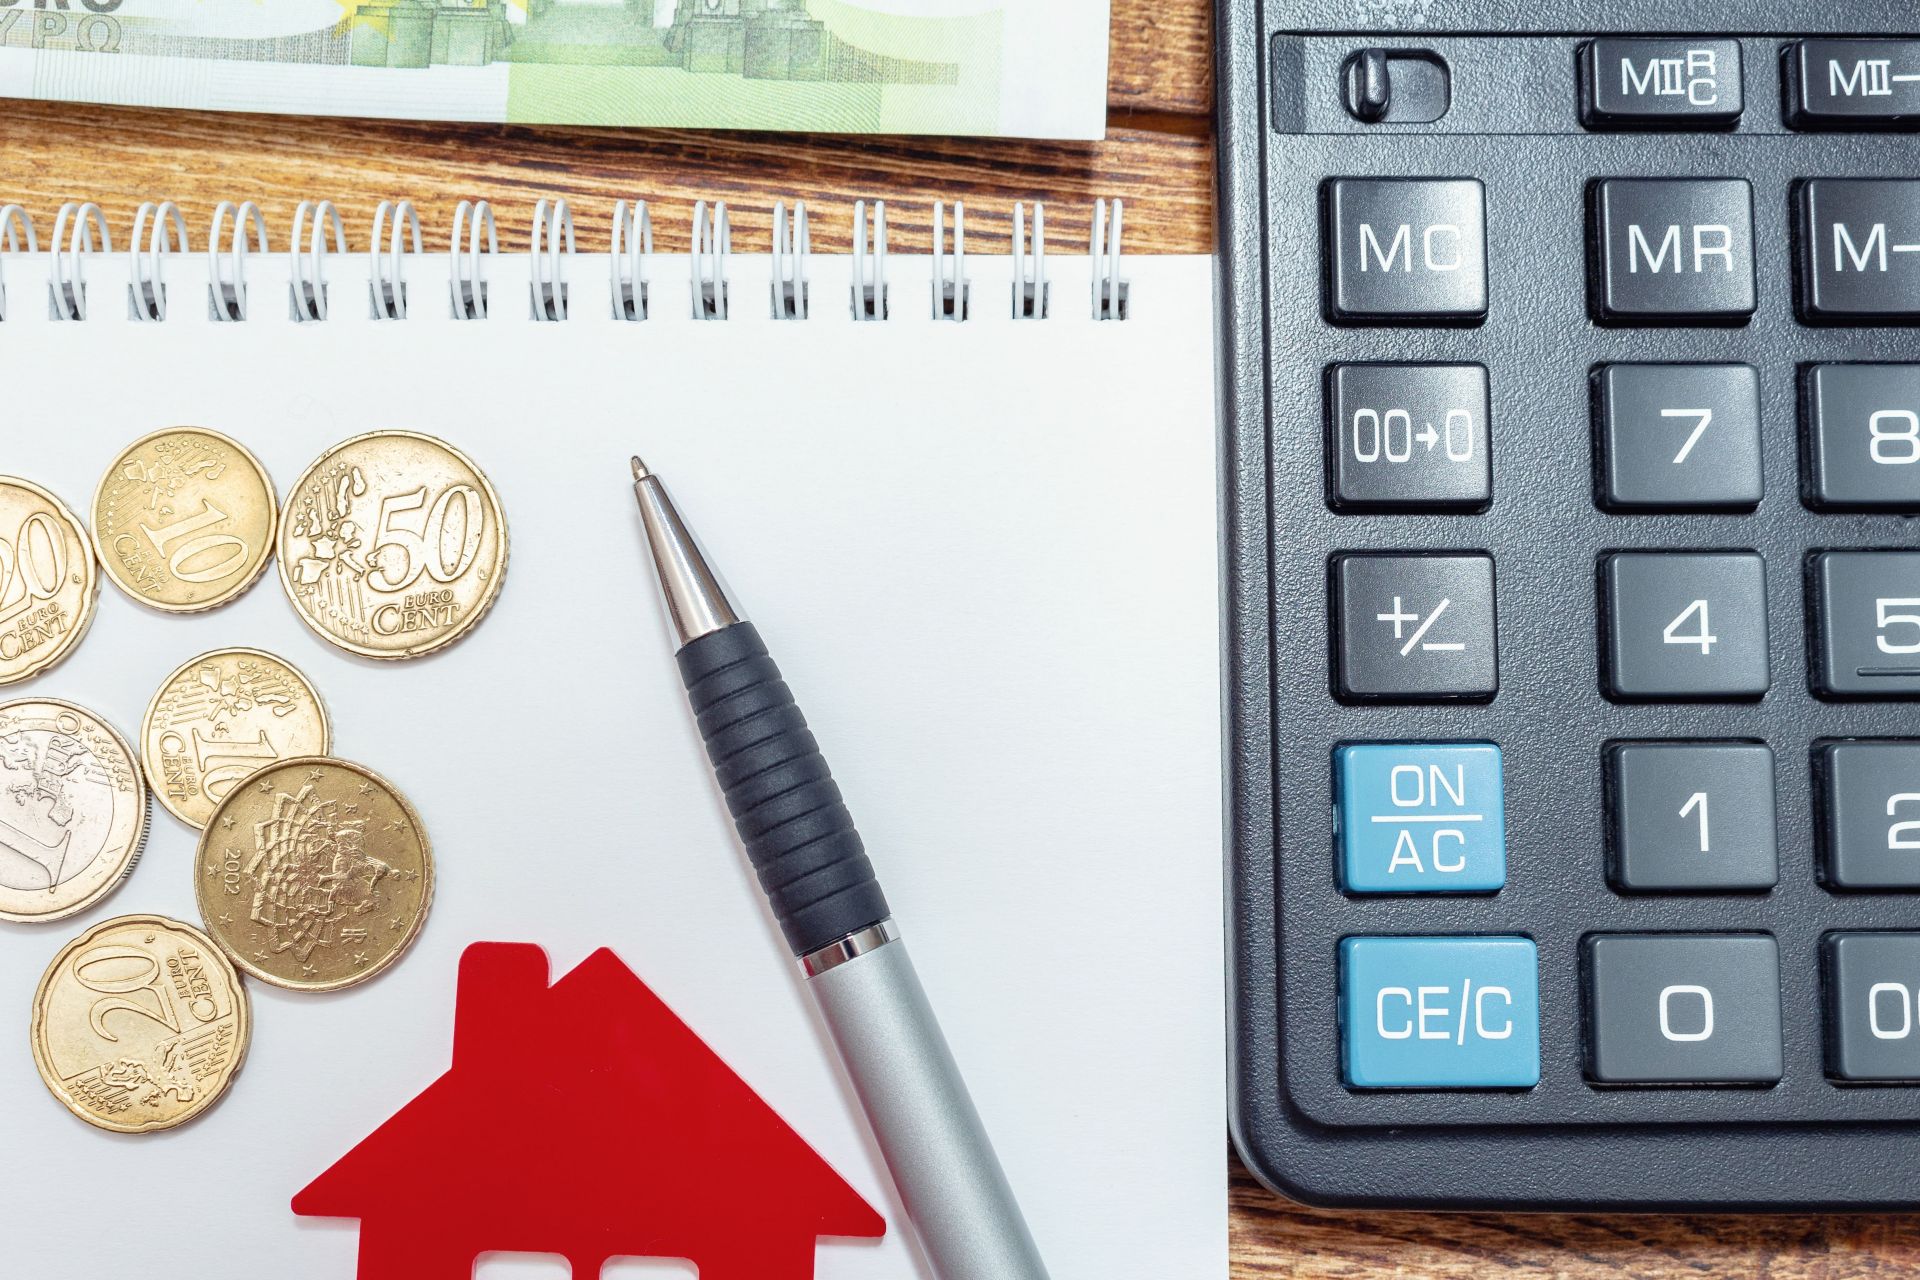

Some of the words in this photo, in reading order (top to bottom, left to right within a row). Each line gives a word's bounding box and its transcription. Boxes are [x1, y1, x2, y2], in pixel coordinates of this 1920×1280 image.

[1359, 222, 1464, 273] MC
[1628, 222, 1733, 274] MR
[1660, 408, 1713, 464] 7
[1869, 409, 1920, 465] 8
[113, 532, 162, 594] CENT
[139, 498, 250, 583] 10
[366, 484, 484, 592] 50
[17, 601, 60, 632] EURO
[371, 602, 461, 636] CENT
[404, 589, 454, 610] EURO
[1663, 599, 1718, 655] 4
[1875, 597, 1920, 654] 5
[0, 611, 69, 661] CENT
[159, 730, 188, 802] CENT
[182, 756, 199, 796] EURO
[1390, 764, 1465, 807] ON
[1678, 792, 1710, 852] 1
[1886, 792, 1920, 850] 2
[223, 848, 241, 896] 2002
[1388, 829, 1466, 873] AC
[73, 944, 181, 1042] 20
[167, 957, 191, 999] EURO
[178, 948, 217, 1022] CENT
[1376, 978, 1513, 1046] CE/C
[1659, 984, 1714, 1042] 0
[1868, 982, 1920, 1040] 0
